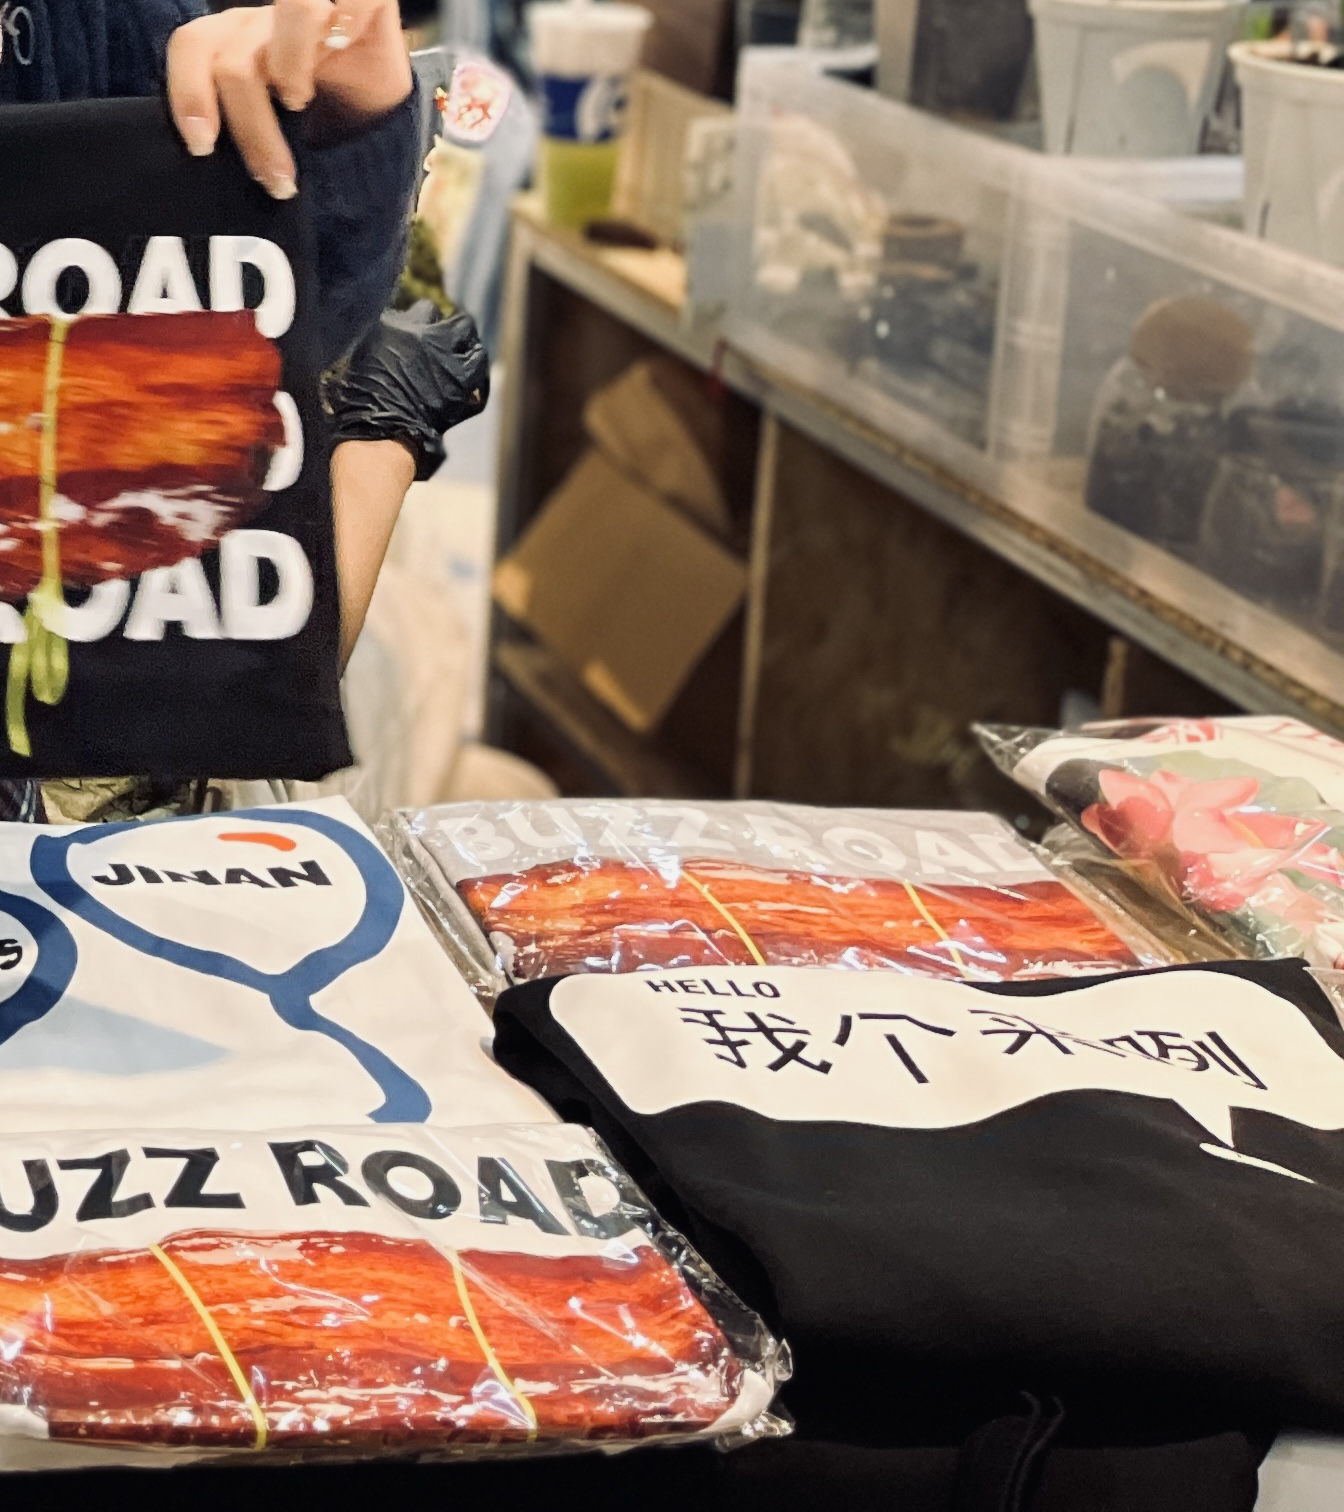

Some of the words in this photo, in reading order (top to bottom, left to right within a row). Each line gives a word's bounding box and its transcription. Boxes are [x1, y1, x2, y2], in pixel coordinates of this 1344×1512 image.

[433, 804, 739, 864] BUZZ
[92, 859, 334, 889] JINAN
[645, 978, 781, 1000] HELLO
[269, 1138, 640, 1241] ROAD
